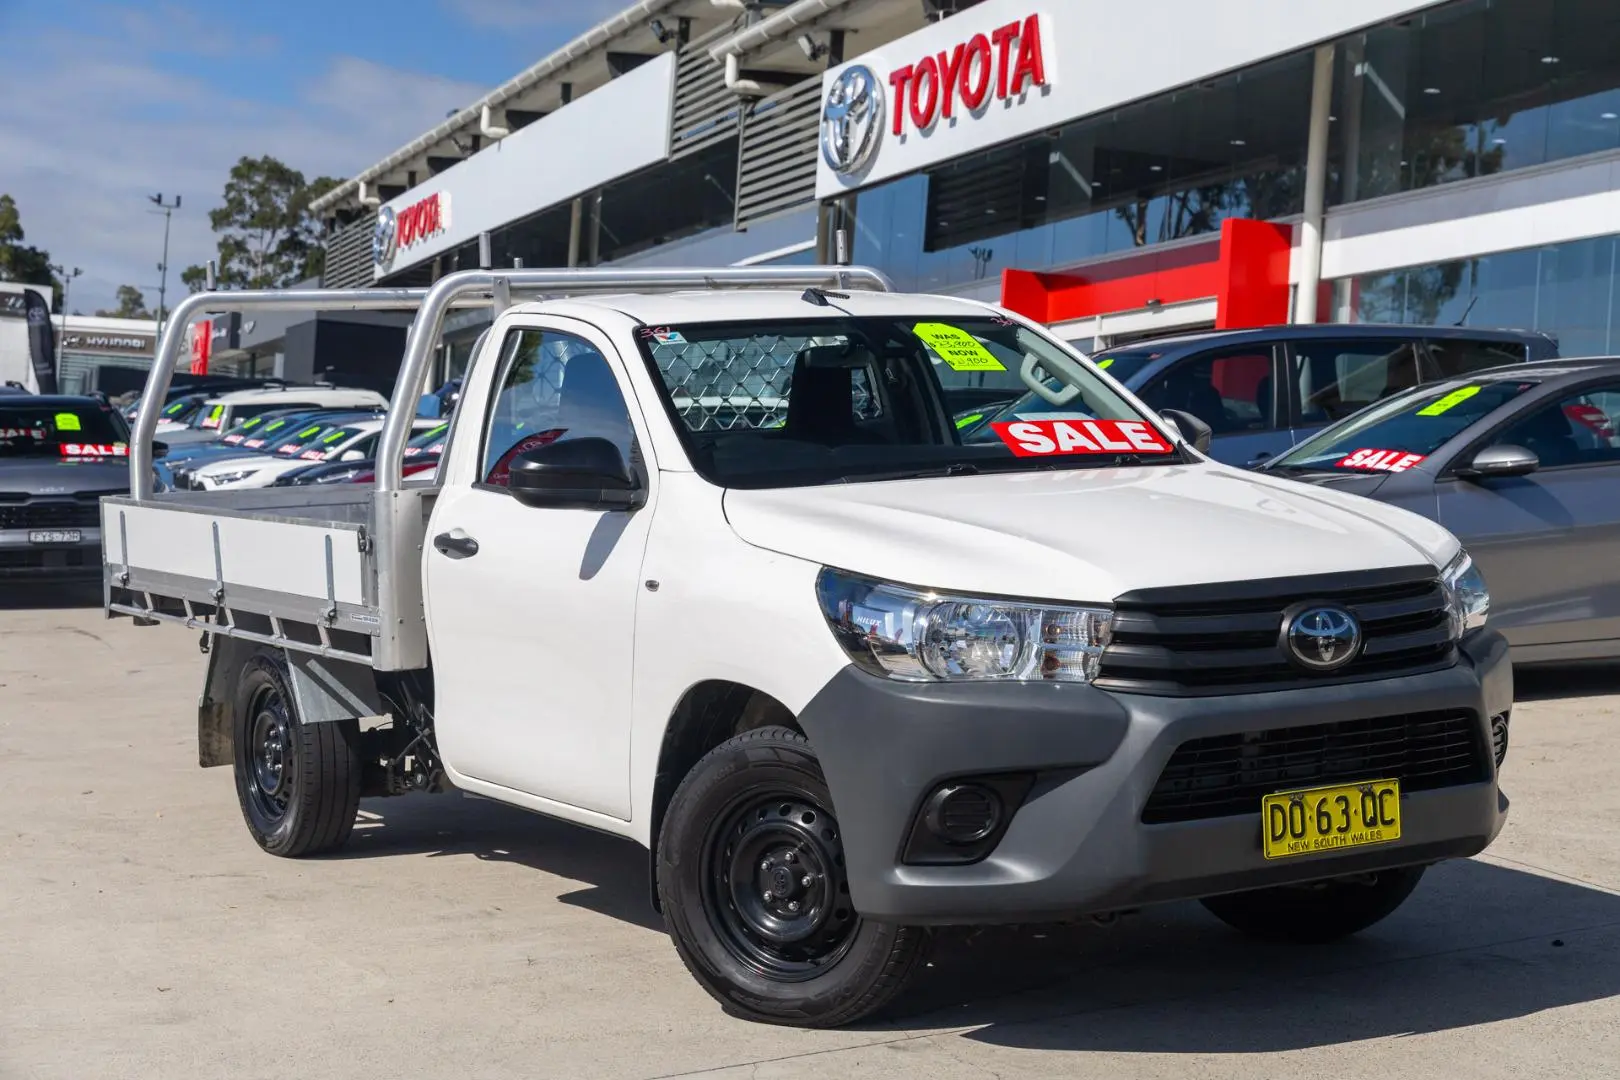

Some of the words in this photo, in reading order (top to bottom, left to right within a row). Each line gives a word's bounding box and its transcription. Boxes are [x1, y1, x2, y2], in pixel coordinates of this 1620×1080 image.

[889, 12, 1046, 136] TOYOTA
[396, 191, 441, 249] TOYOTA
[1008, 422, 1165, 453] SALE
[65, 444, 127, 456] SALE
[1343, 449, 1423, 473] SALE
[856, 615, 883, 627] HILUX
[1287, 840, 1309, 852] NEW
[1313, 834, 1346, 848] SOUTH
[1350, 829, 1383, 843] WALES
